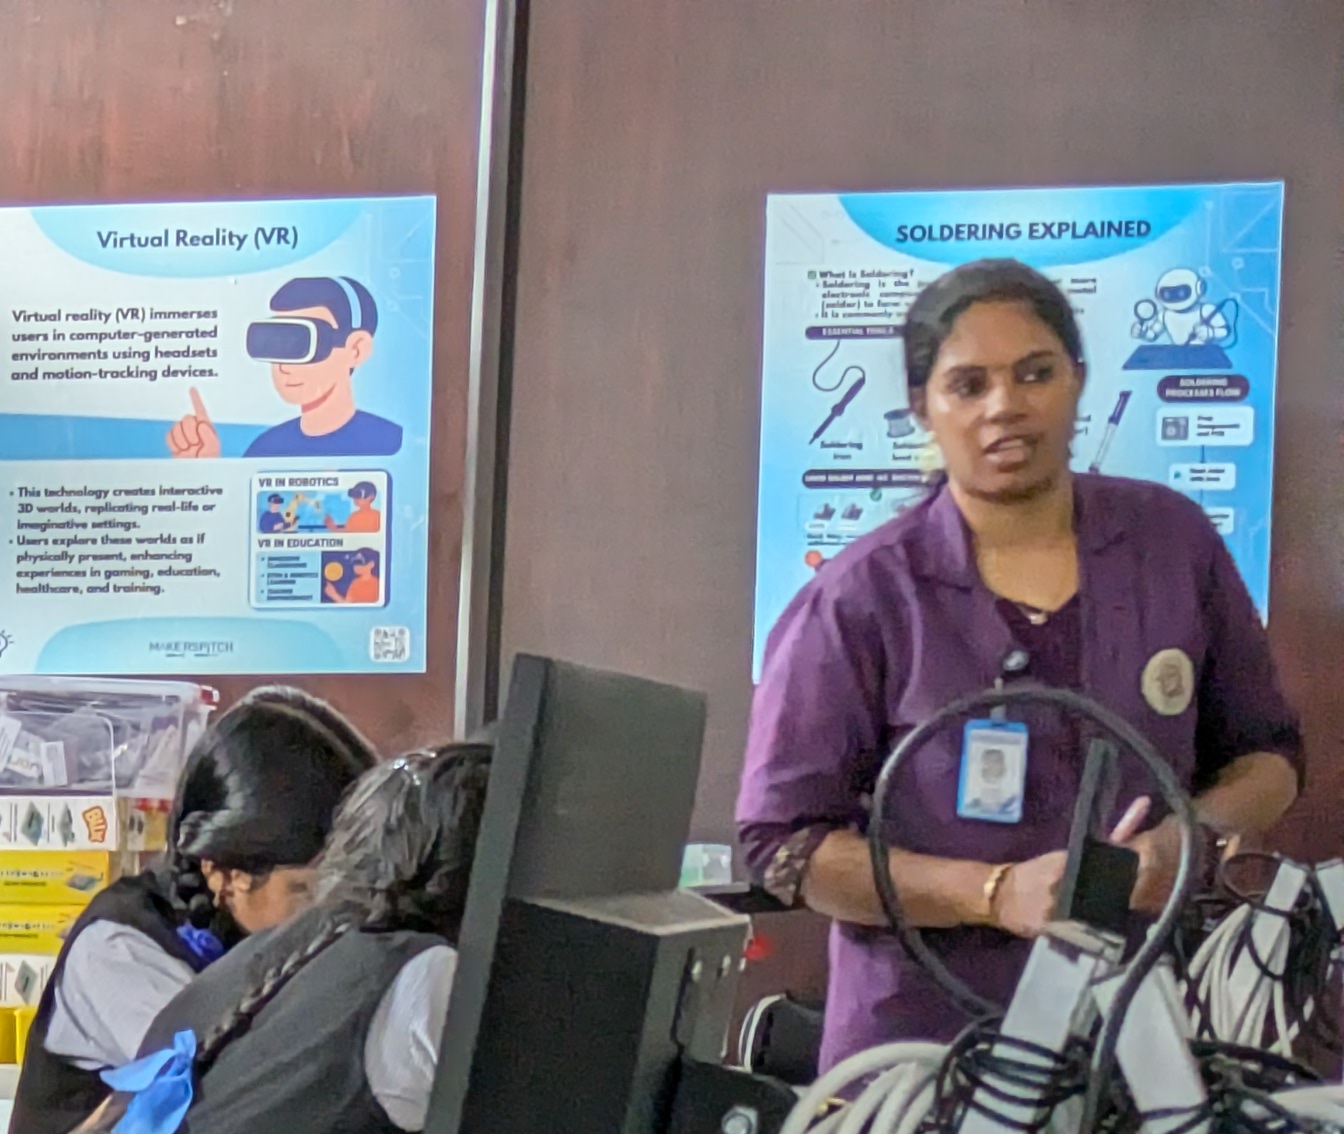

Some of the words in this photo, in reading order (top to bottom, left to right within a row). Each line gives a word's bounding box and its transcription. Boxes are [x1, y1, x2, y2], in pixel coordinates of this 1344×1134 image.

[96, 228, 169, 249] Virtual
[176, 227, 248, 251] Reality
[254, 226, 299, 250] (VR)
[895, 223, 1022, 243] SOLDERING
[1028, 220, 1151, 241] EXPLAINED
[12, 309, 61, 323] Virtual
[65, 308, 112, 324] reality
[115, 307, 146, 324] (VR)
[150, 307, 218, 320] immerses
[12, 331, 49, 342] users
[53, 329, 65, 341] in
[69, 326, 218, 343] computer-generated
[11, 348, 108, 361] environments
[112, 347, 151, 362] using
[154, 346, 218, 359] headsets
[11, 367, 39, 381] and
[42, 366, 158, 381] motion-tracking
[162, 364, 218, 378] devices.
[258, 478, 272, 487] VR
[275, 478, 285, 487] IN
[288, 477, 339, 487] ROBOTICS
[17, 486, 41, 498] This
[44, 485, 110, 499] technology
[112, 486, 156, 497] creates
[159, 484, 223, 497] interactive
[17, 503, 34, 513] 3D
[36, 502, 81, 514] worlds,
[84, 501, 149, 515] replicating
[152, 501, 199, 513] real-life
[202, 504, 216, 512] or
[17, 518, 88, 532] imaginative
[91, 518, 141, 532] settings.
[16, 535, 49, 546] Users
[52, 534, 98, 548] explore
[101, 533, 132, 545] these
[135, 533, 177, 545] worlds
[180, 536, 193, 544] as
[196, 533, 206, 544] if
[258, 539, 271, 548] VR
[274, 539, 284, 548] IN
[287, 538, 343, 548] EDUCATION
[16, 551, 75, 564] physically
[78, 551, 127, 564] present,
[130, 550, 193, 563] enhancing
[16, 567, 87, 580] experiences
[90, 567, 101, 577] in
[104, 567, 154, 580] gaming,
[157, 566, 221, 578] education,
[16, 582, 83, 595] healthcare,
[87, 582, 110, 594] and
[113, 581, 165, 595] training.
